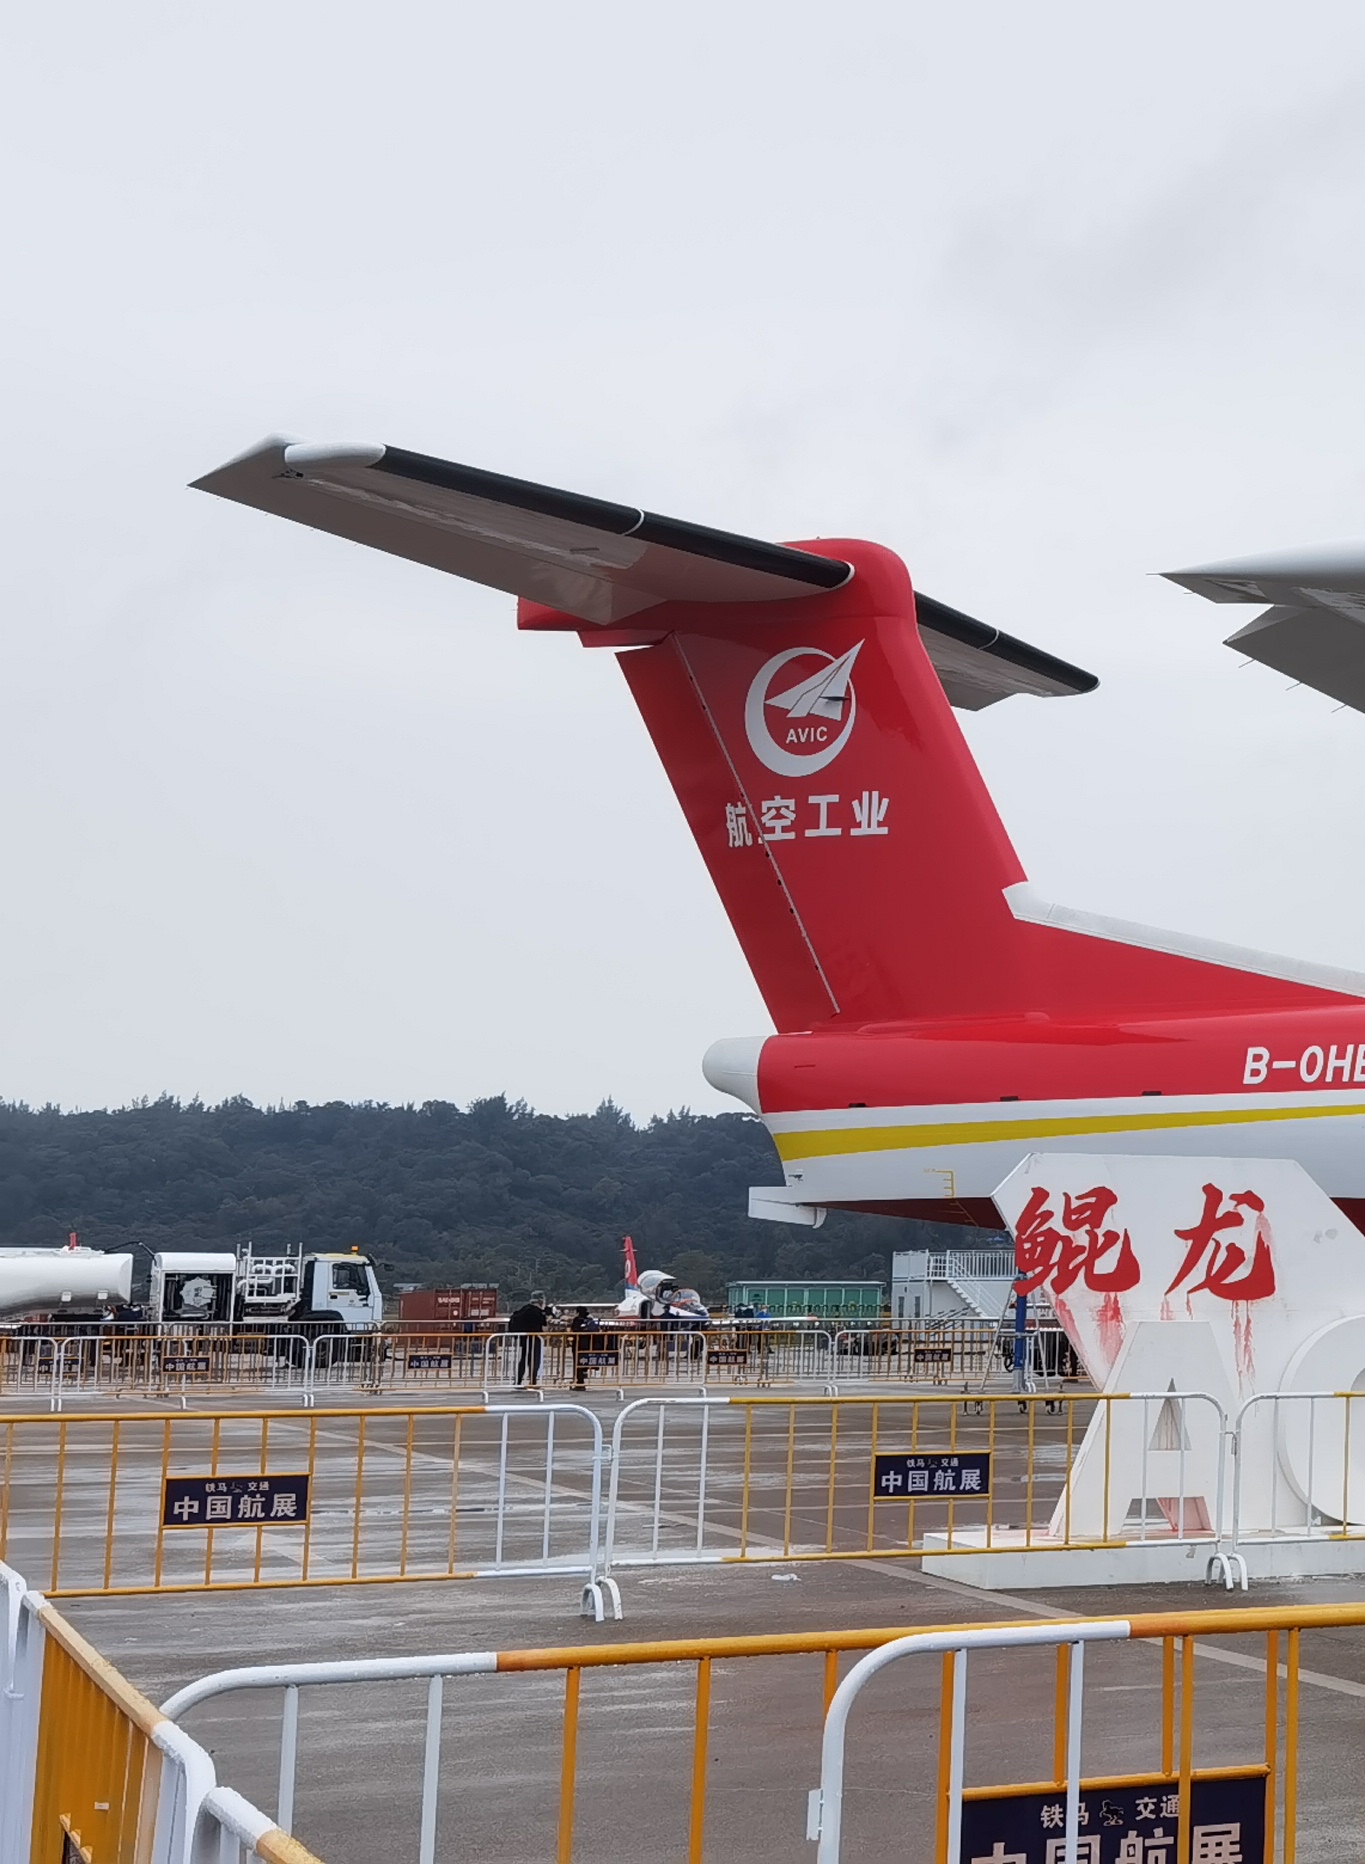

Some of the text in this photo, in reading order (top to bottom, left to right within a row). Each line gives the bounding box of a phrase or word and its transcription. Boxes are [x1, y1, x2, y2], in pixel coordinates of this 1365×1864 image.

[786, 726, 828, 744] AVIC
[725, 791, 889, 848] 航空工业
[1013, 1183, 1276, 1301] 鲲龙
[881, 1469, 982, 1493] 中国航展
[173, 1493, 298, 1521] 中国航展
